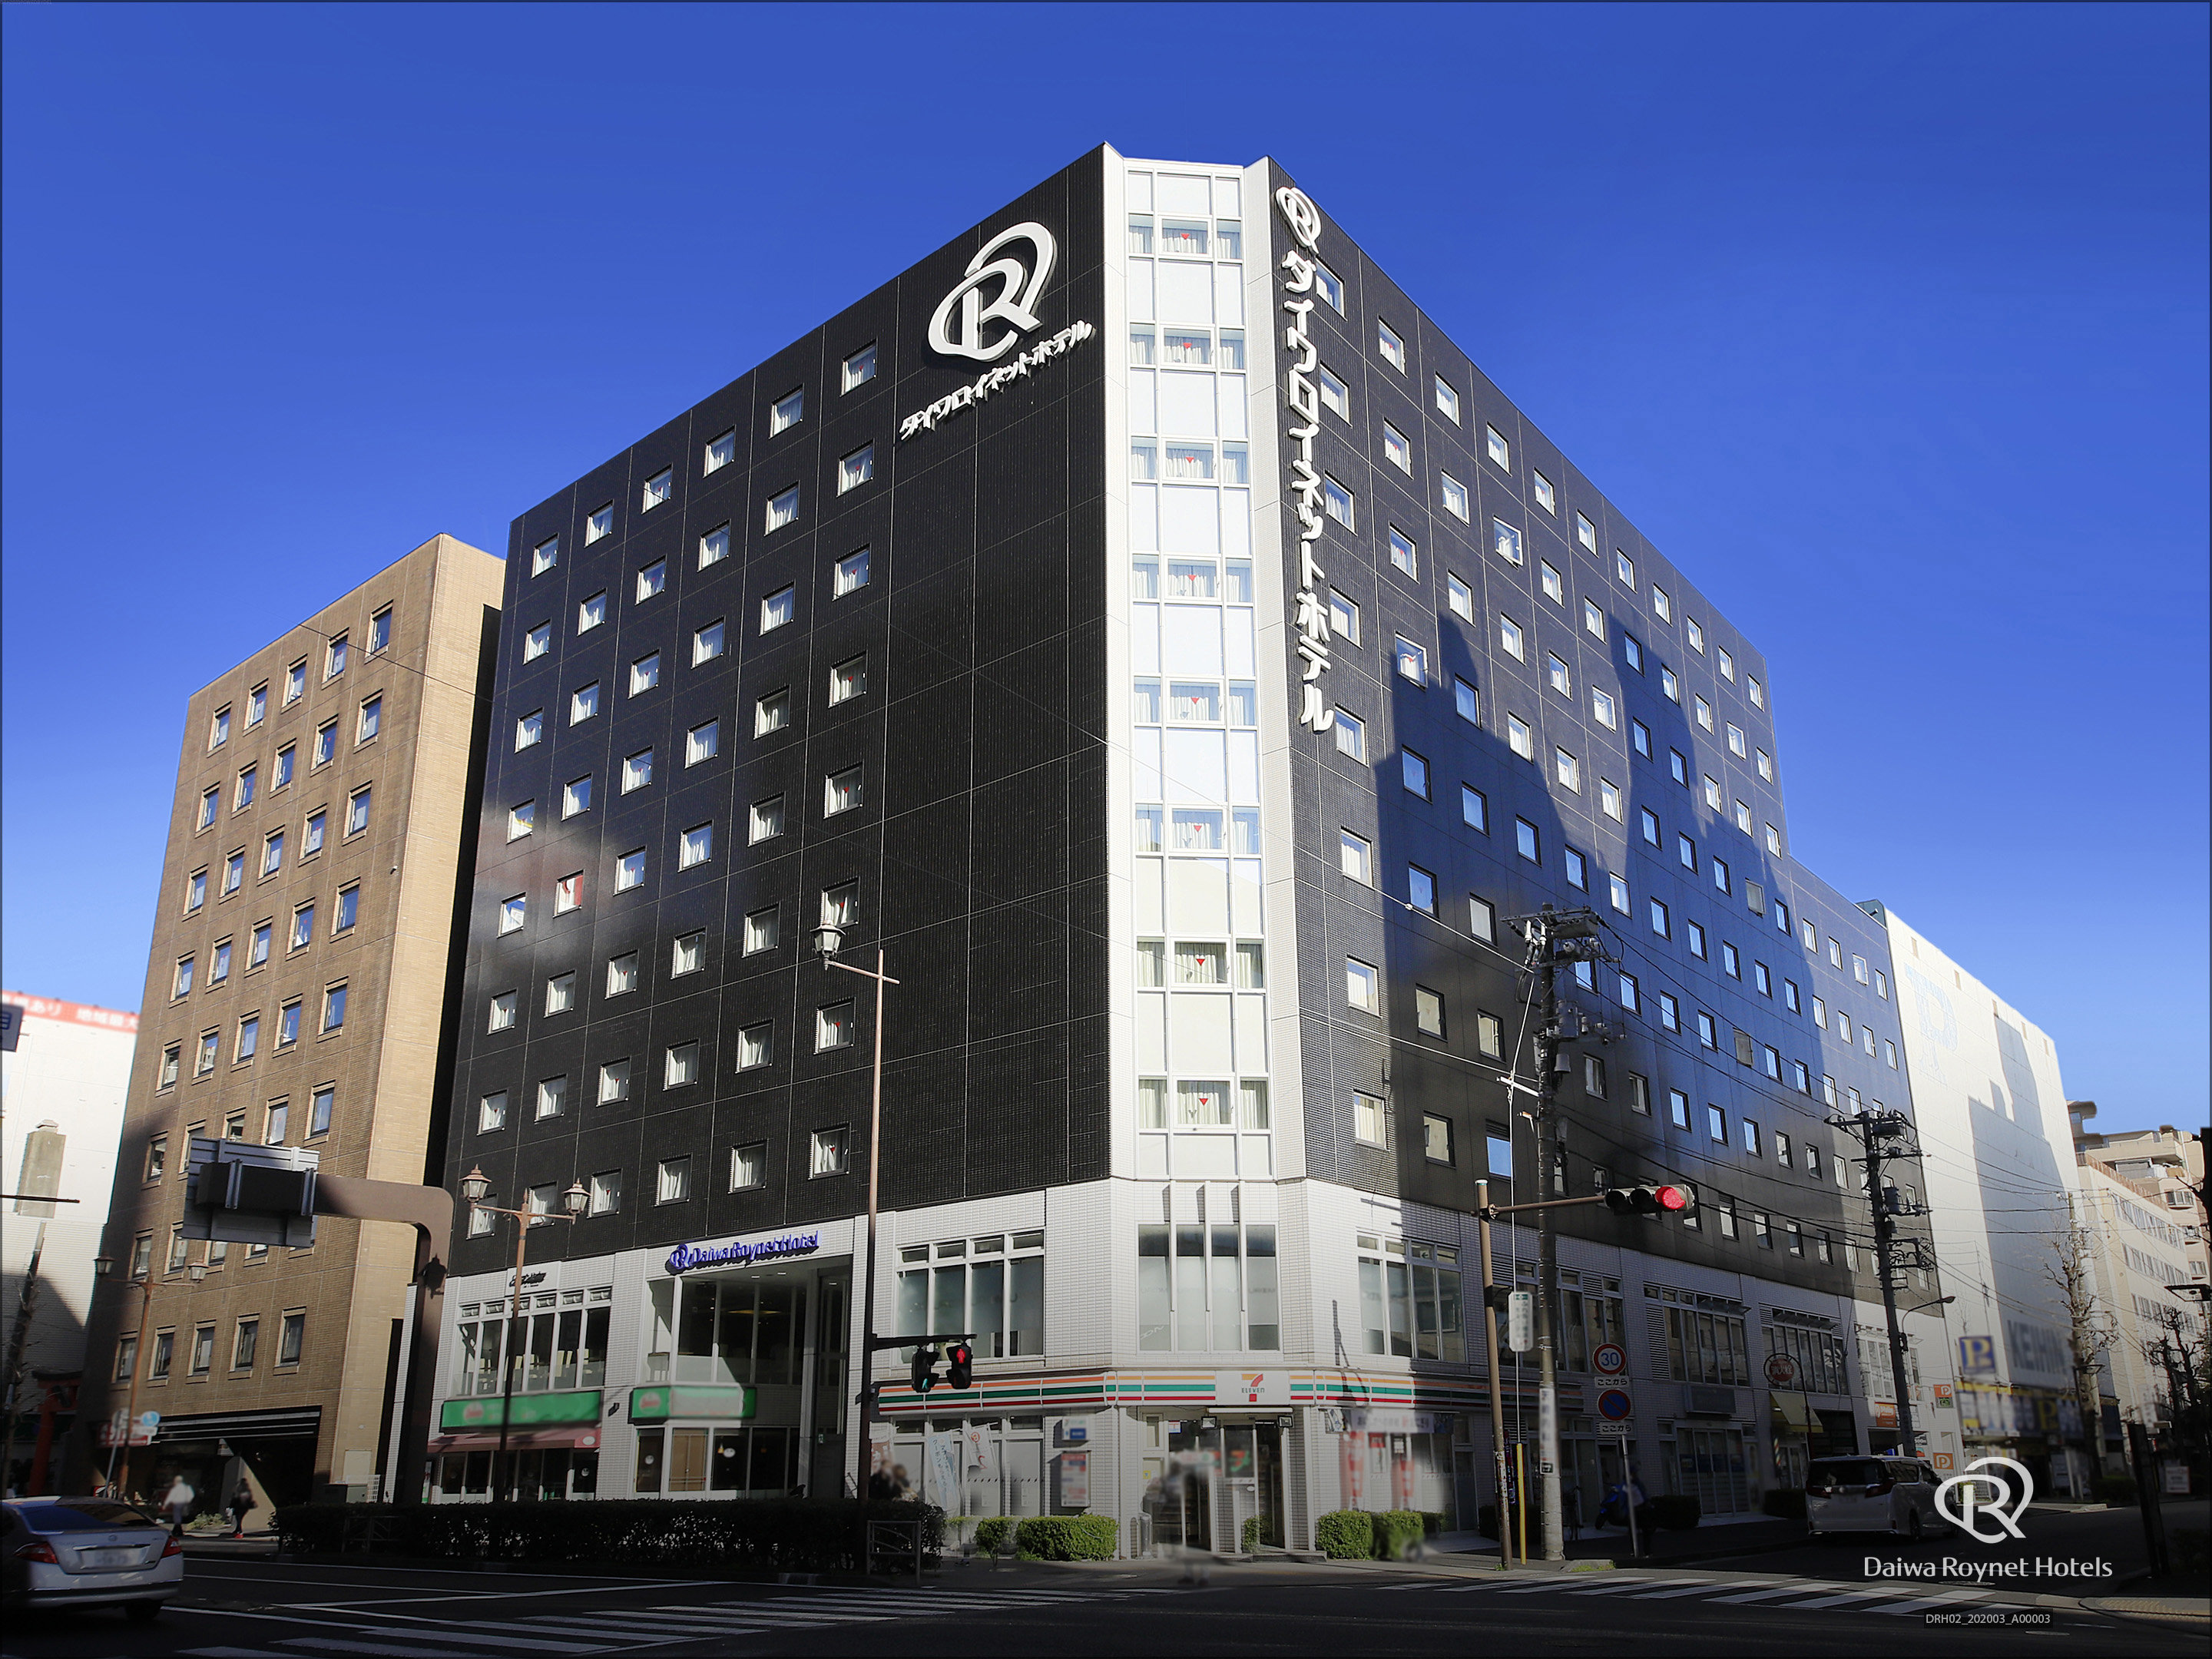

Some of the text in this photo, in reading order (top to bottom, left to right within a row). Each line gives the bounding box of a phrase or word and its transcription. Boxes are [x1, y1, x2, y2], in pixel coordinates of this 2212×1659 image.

[899, 320, 1096, 441] ダイワロイネットホテル
[1282, 250, 1334, 731] ダイワロイネットホテル
[783, 1230, 820, 1251] Hotel
[1601, 1353, 1618, 1366] 30
[1936, 1455, 1951, 1469] P
